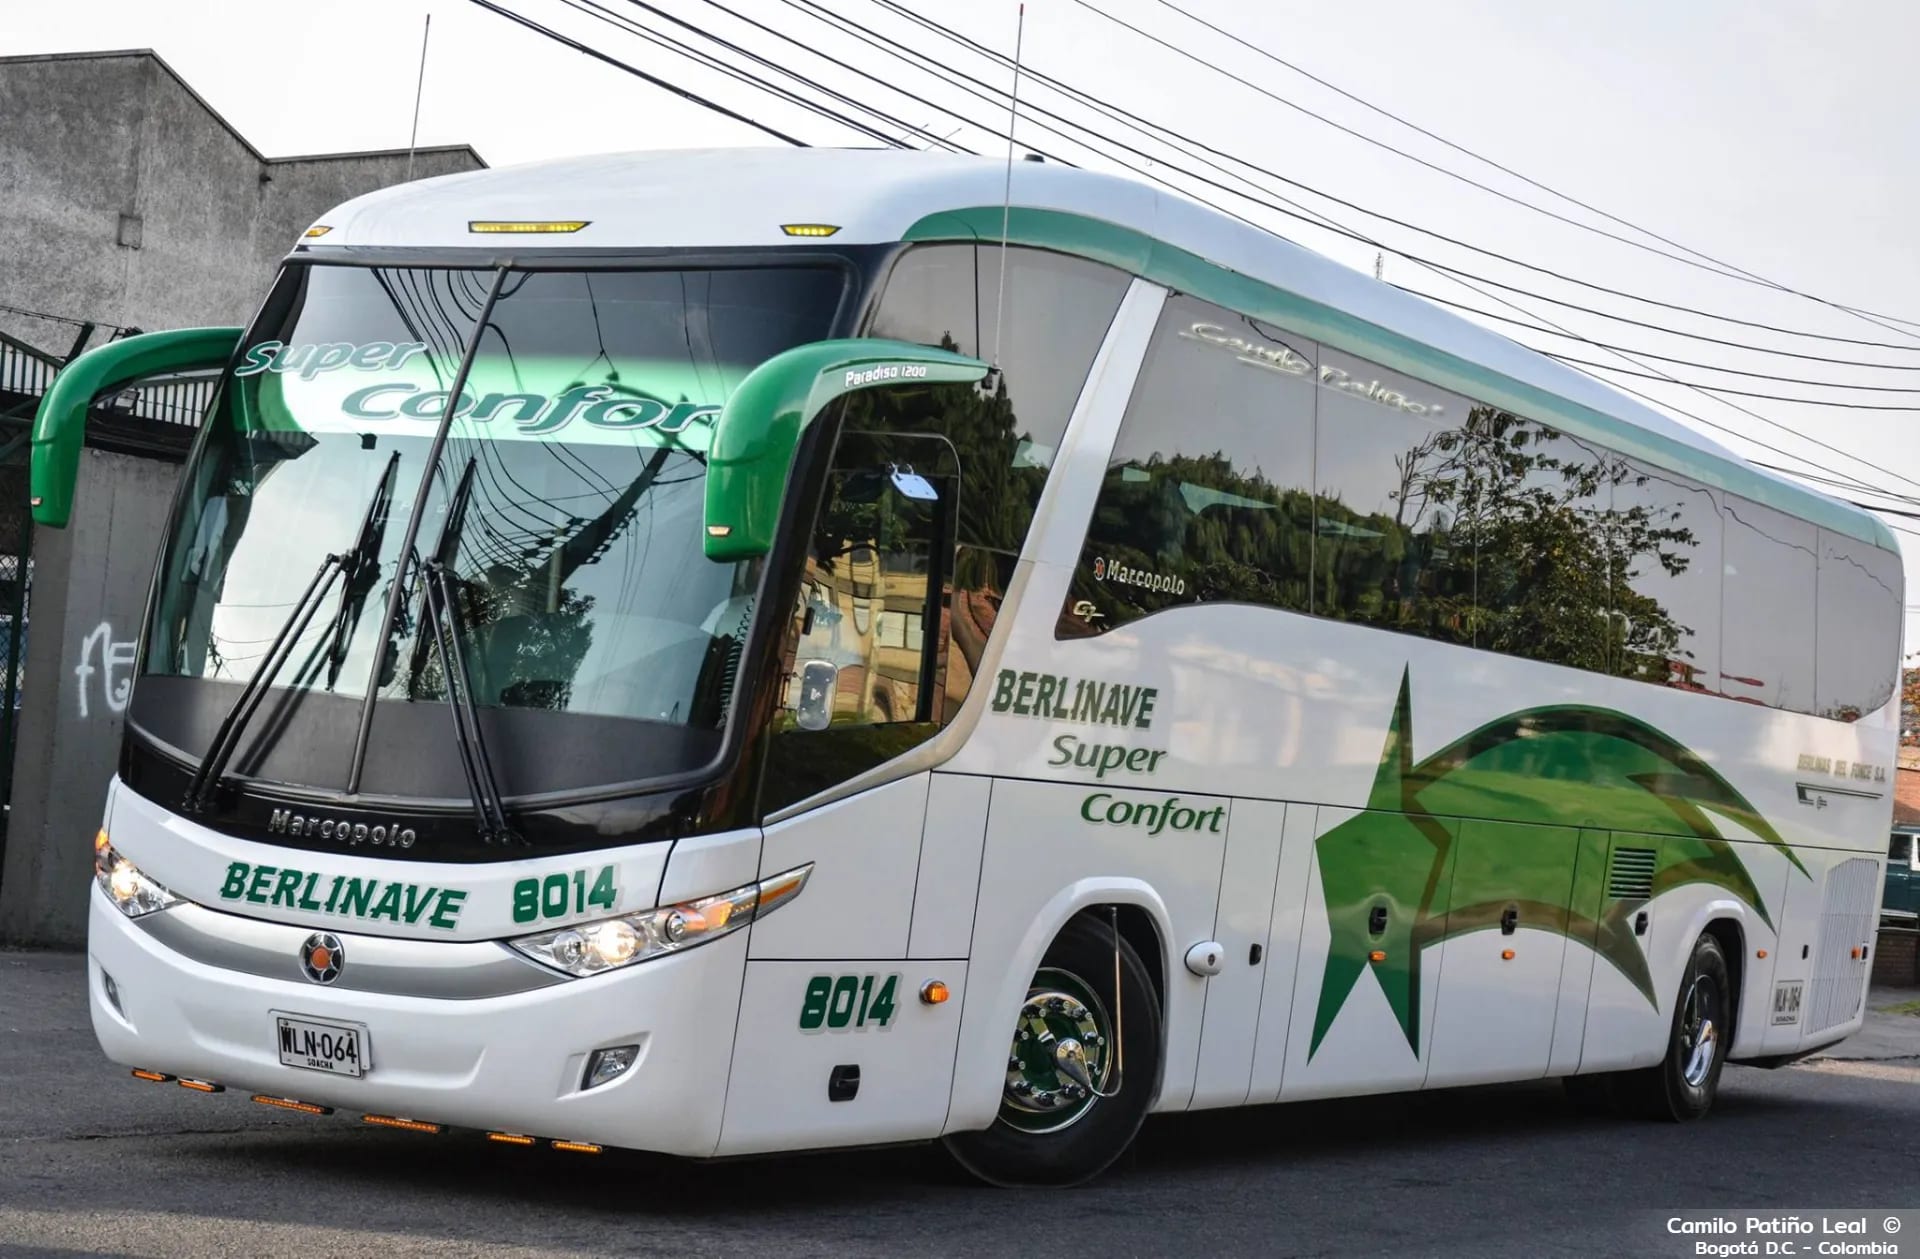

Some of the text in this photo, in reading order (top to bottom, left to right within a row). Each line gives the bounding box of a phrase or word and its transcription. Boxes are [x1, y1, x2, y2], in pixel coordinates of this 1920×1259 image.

[234, 340, 428, 381] Super
[845, 364, 927, 388] Paradiso 1200
[341, 383, 723, 436] Confor
[1106, 559, 1186, 596] Marcopolo
[991, 667, 1158, 729] BERLINAVE
[1047, 734, 1167, 779] Super
[267, 808, 416, 849] Marcopolo
[1080, 793, 1225, 836] Confort
[220, 861, 468, 930] BERLINAVE
[512, 865, 618, 924] 8014
[799, 975, 897, 1029] 8014
[307, 1058, 333, 1070] SOACHA
